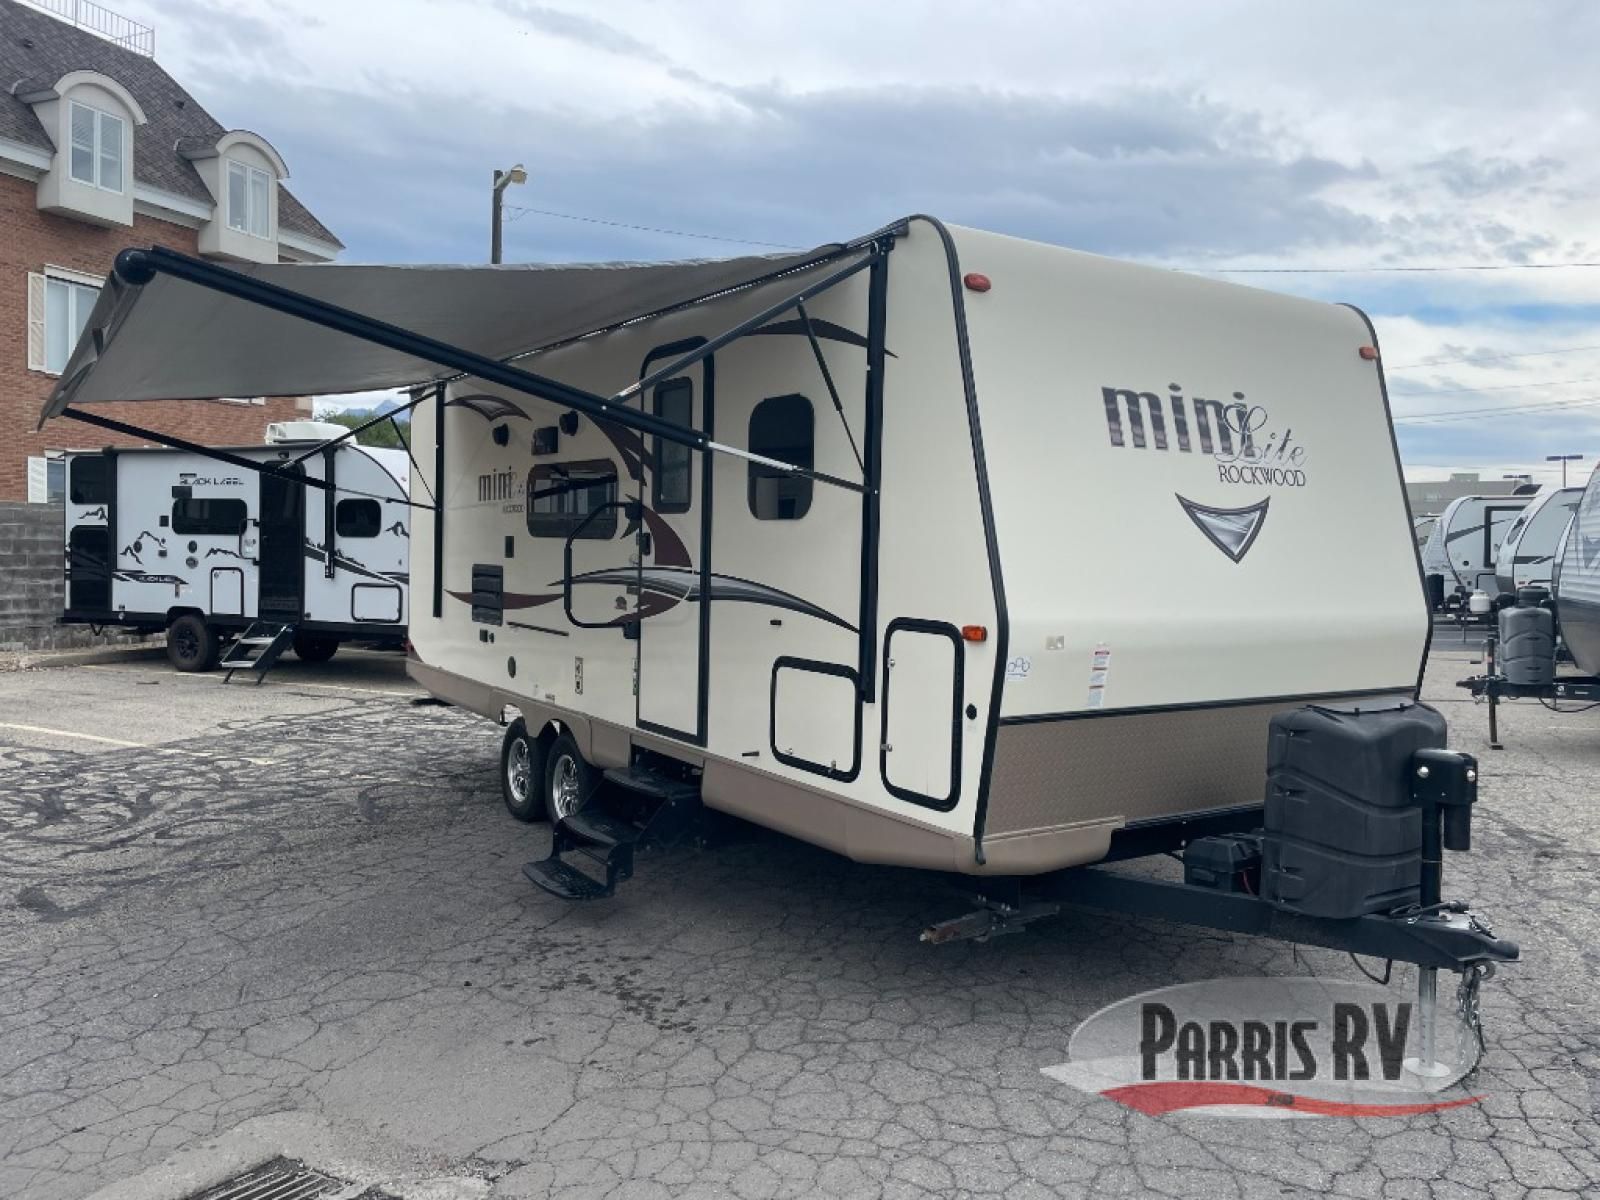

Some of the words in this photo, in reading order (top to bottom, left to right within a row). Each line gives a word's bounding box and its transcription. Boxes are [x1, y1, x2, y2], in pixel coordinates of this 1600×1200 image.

[1101, 382, 1256, 457] mini
[1214, 403, 1308, 466] Lite
[1217, 464, 1306, 487] ROCKWOOD
